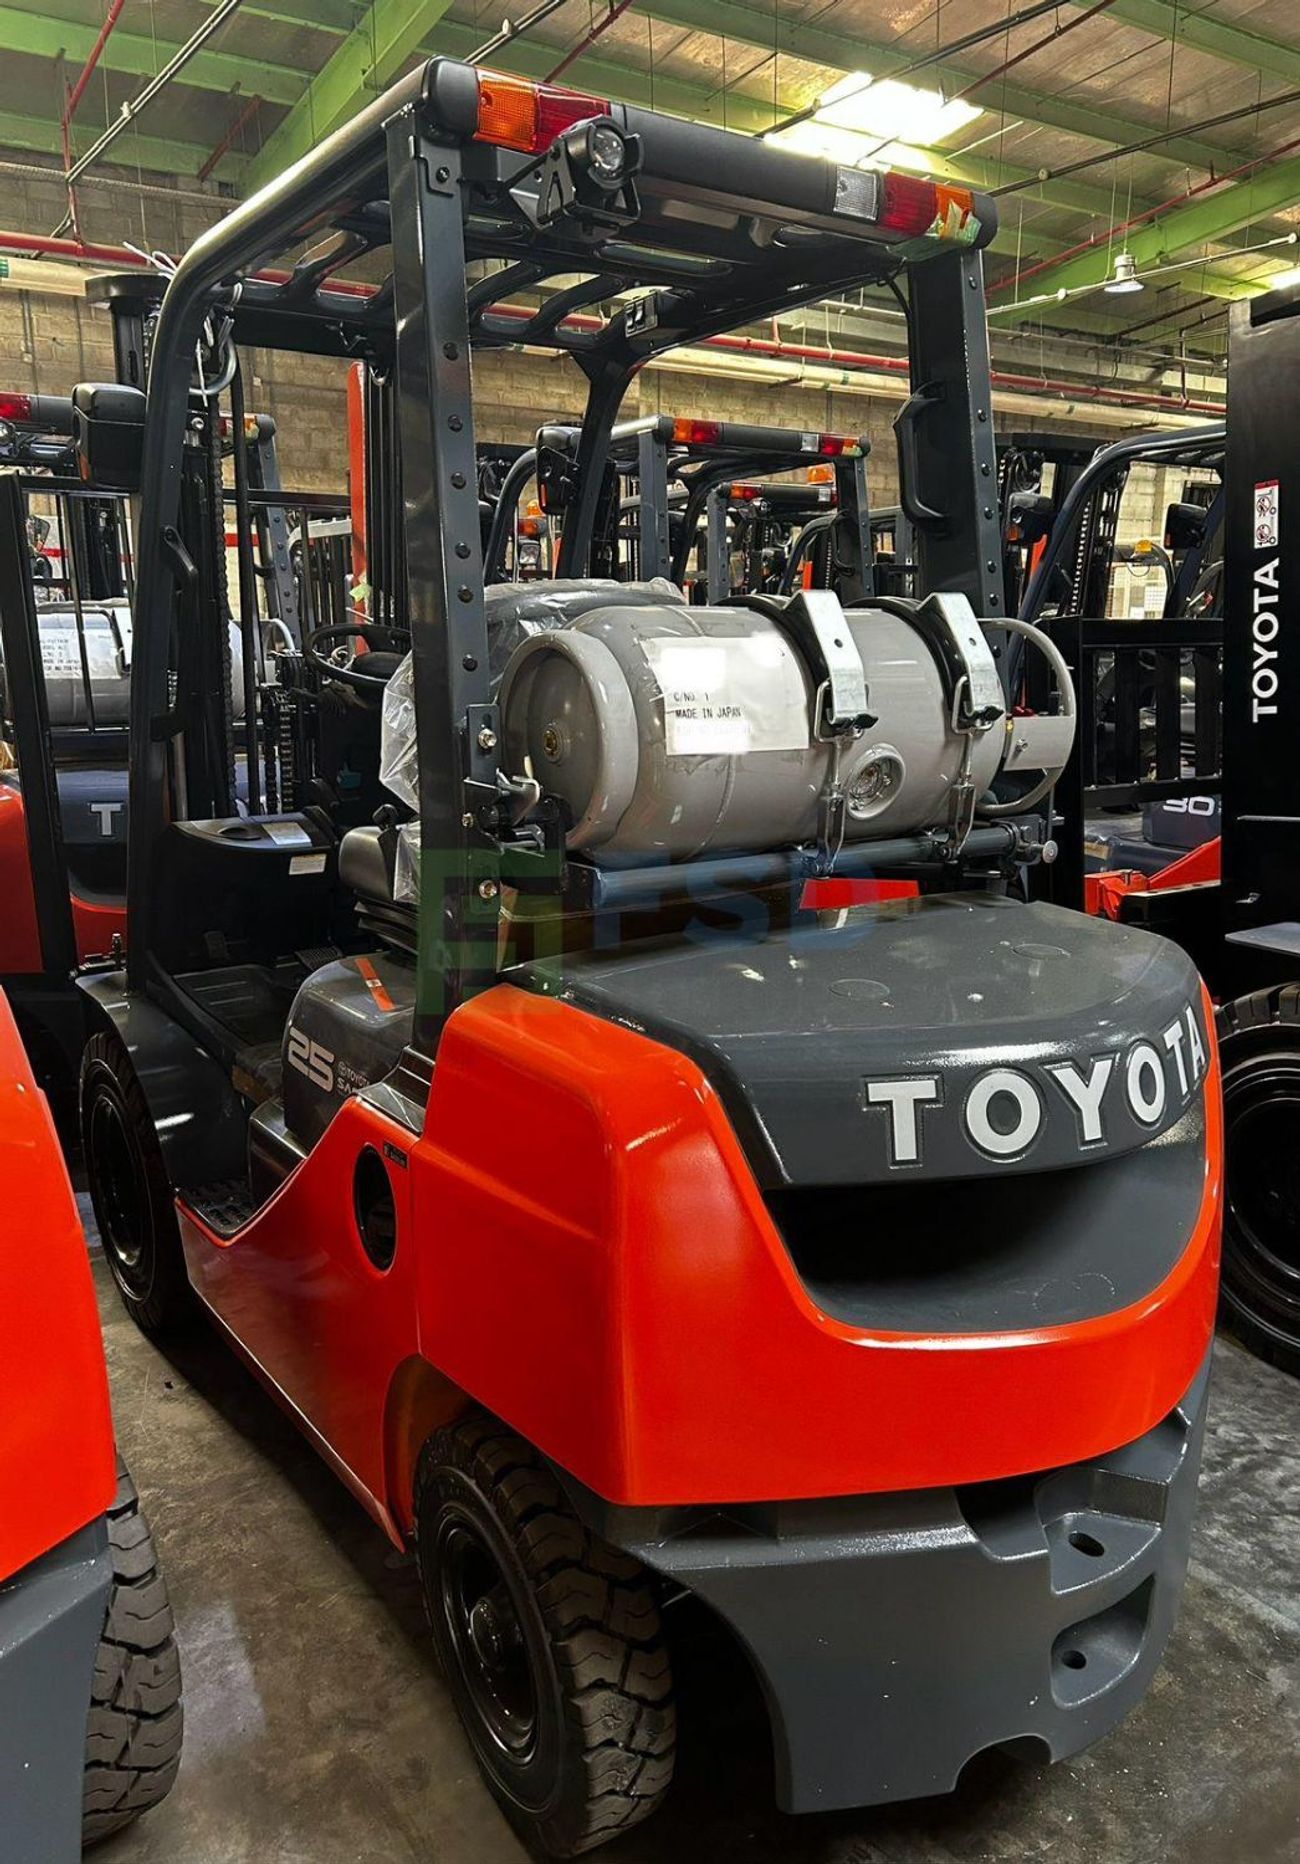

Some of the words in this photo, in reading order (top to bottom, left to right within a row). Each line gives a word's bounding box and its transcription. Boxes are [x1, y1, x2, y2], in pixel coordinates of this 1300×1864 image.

[1252, 557, 1280, 723] TOYOTA
[675, 707, 697, 719] MADE
[703, 707, 713, 719] IN
[717, 706, 742, 719] JAPAN
[288, 1026, 335, 1092] 25
[867, 1005, 1206, 1161] TOYOTA
